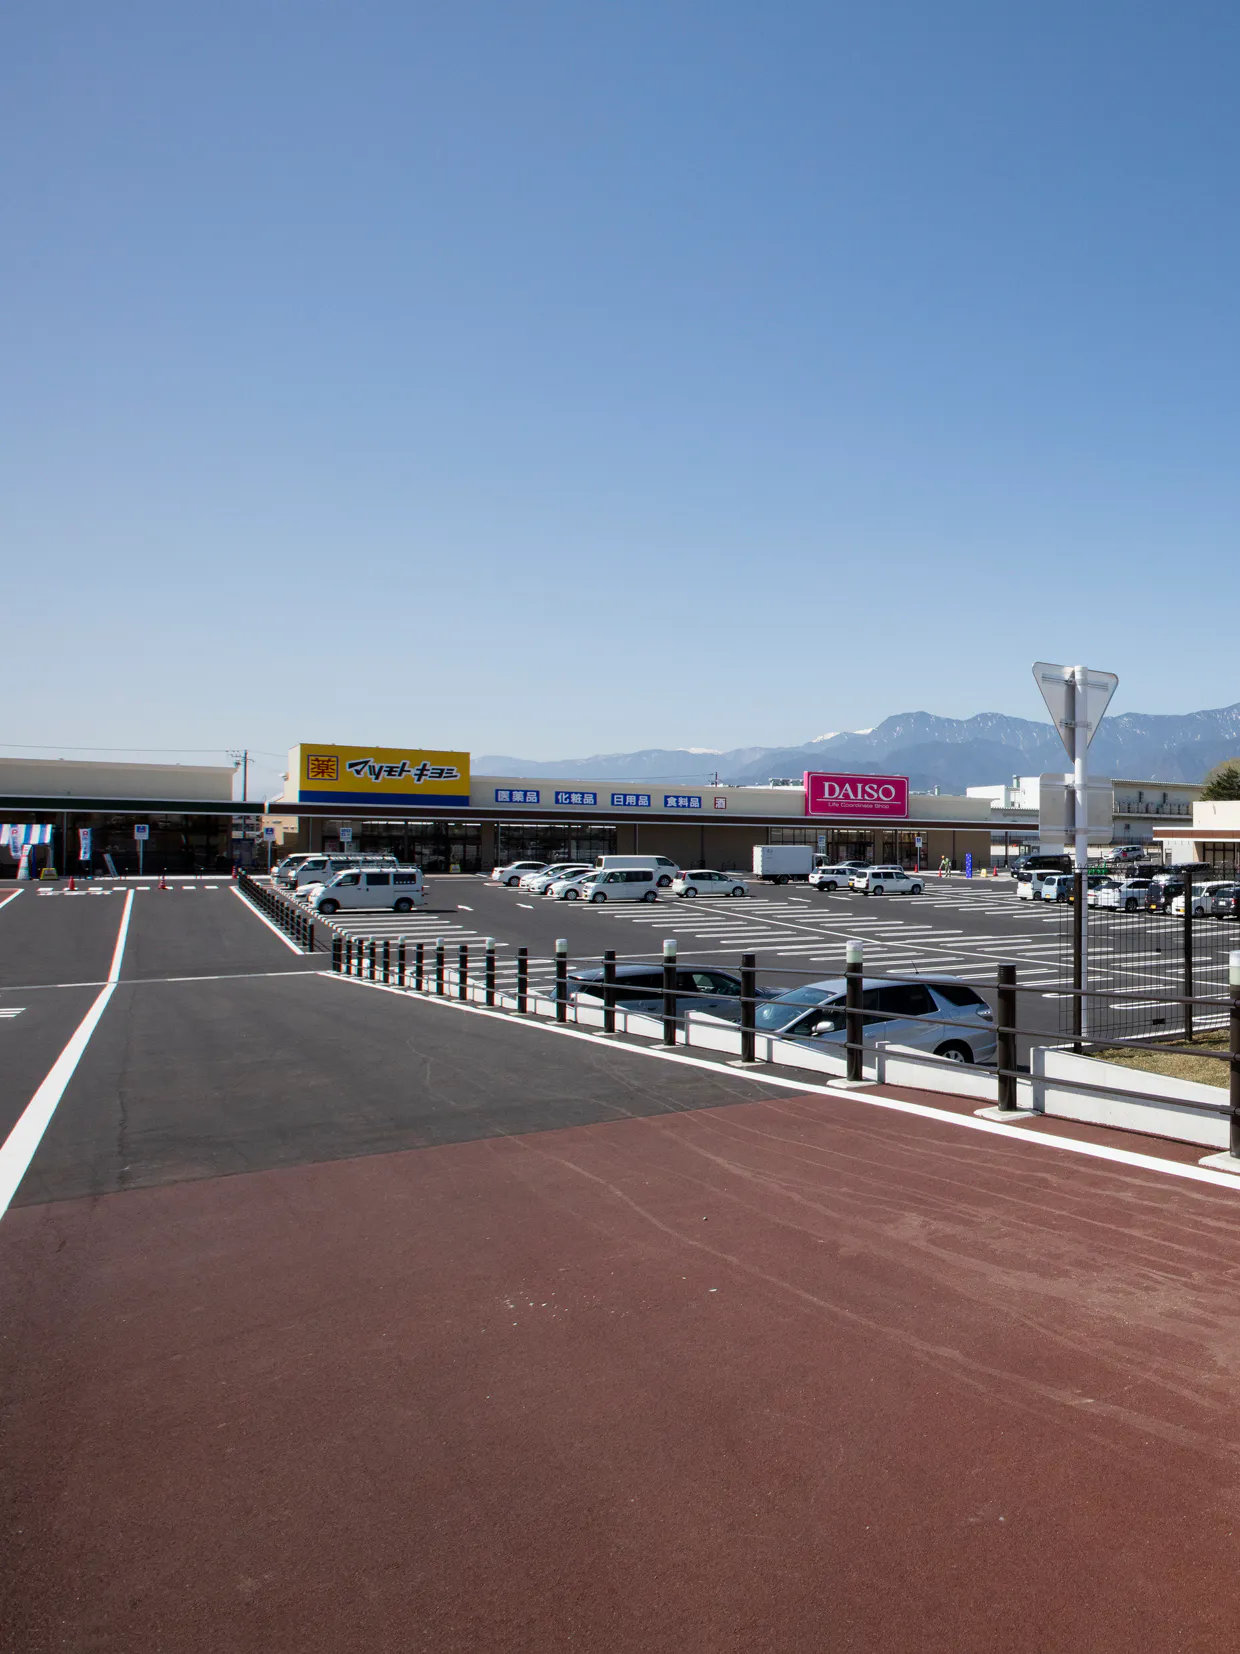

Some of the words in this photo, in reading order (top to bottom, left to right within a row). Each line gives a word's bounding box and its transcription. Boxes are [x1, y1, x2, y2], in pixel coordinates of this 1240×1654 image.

[310, 757, 336, 778] 薬
[346, 758, 461, 785] マツモトキヨシ
[497, 790, 538, 803] 医薬品
[823, 781, 896, 801] DAISO
[557, 792, 595, 805] 化粧品
[613, 794, 649, 806] 日用品
[666, 796, 700, 808] 食料品
